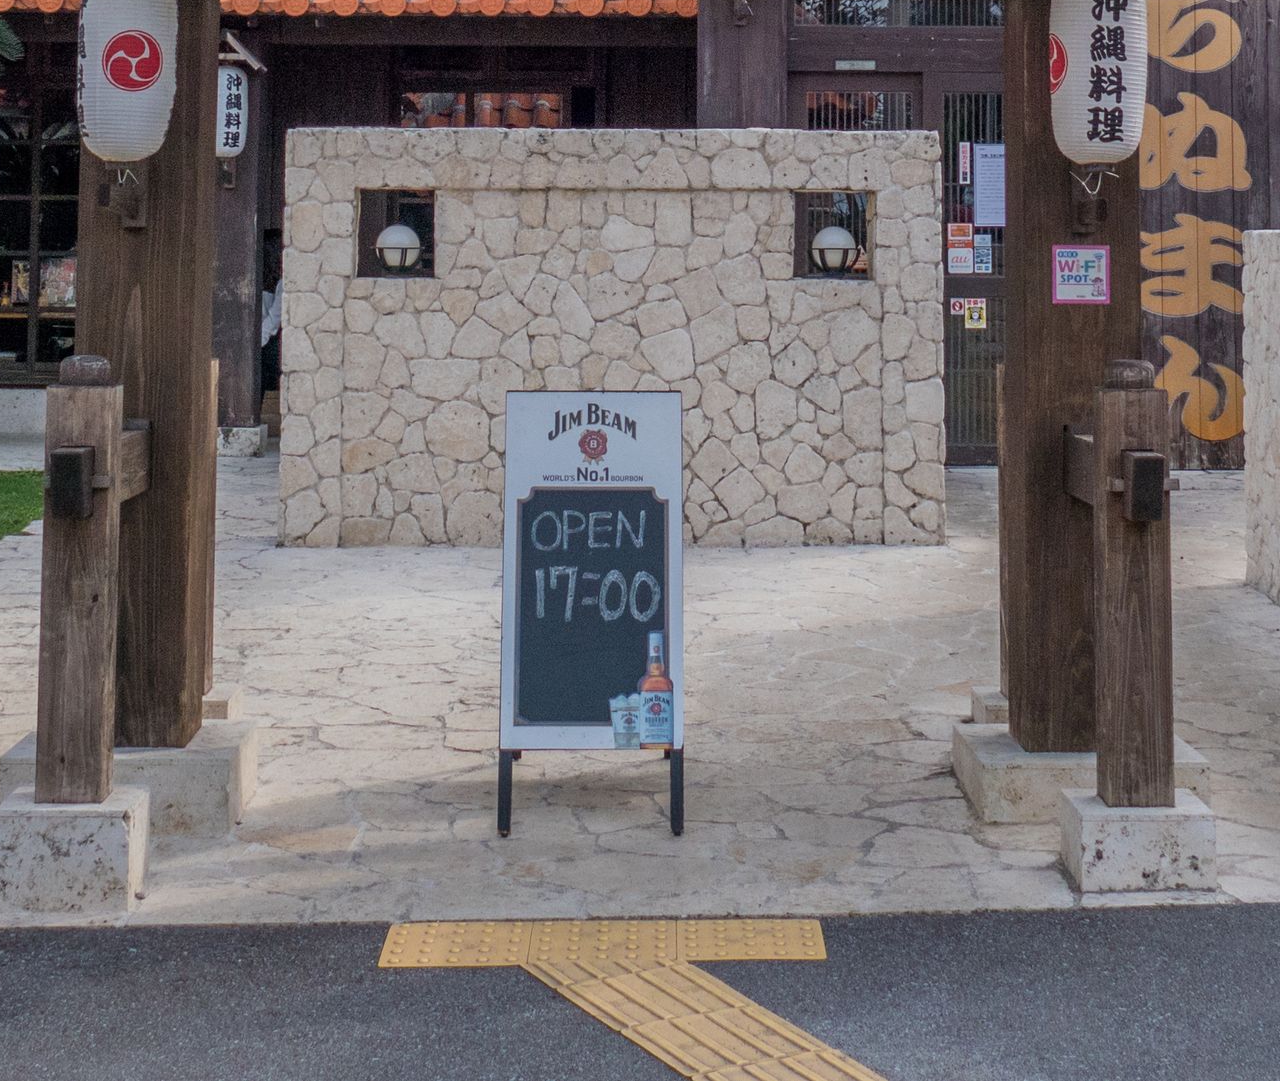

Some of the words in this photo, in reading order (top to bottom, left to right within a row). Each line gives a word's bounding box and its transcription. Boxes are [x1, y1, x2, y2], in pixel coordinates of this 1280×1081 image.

[223, 73, 243, 148] 沖縄料理
[1060, 274, 1089, 283] SPOT
[548, 409, 582, 441] JIM
[586, 402, 637, 441] BEAM
[542, 474, 575, 482] WORLD'S
[576, 466, 609, 482] No.1
[530, 510, 646, 551] OPEN
[535, 566, 661, 622] 17:00
